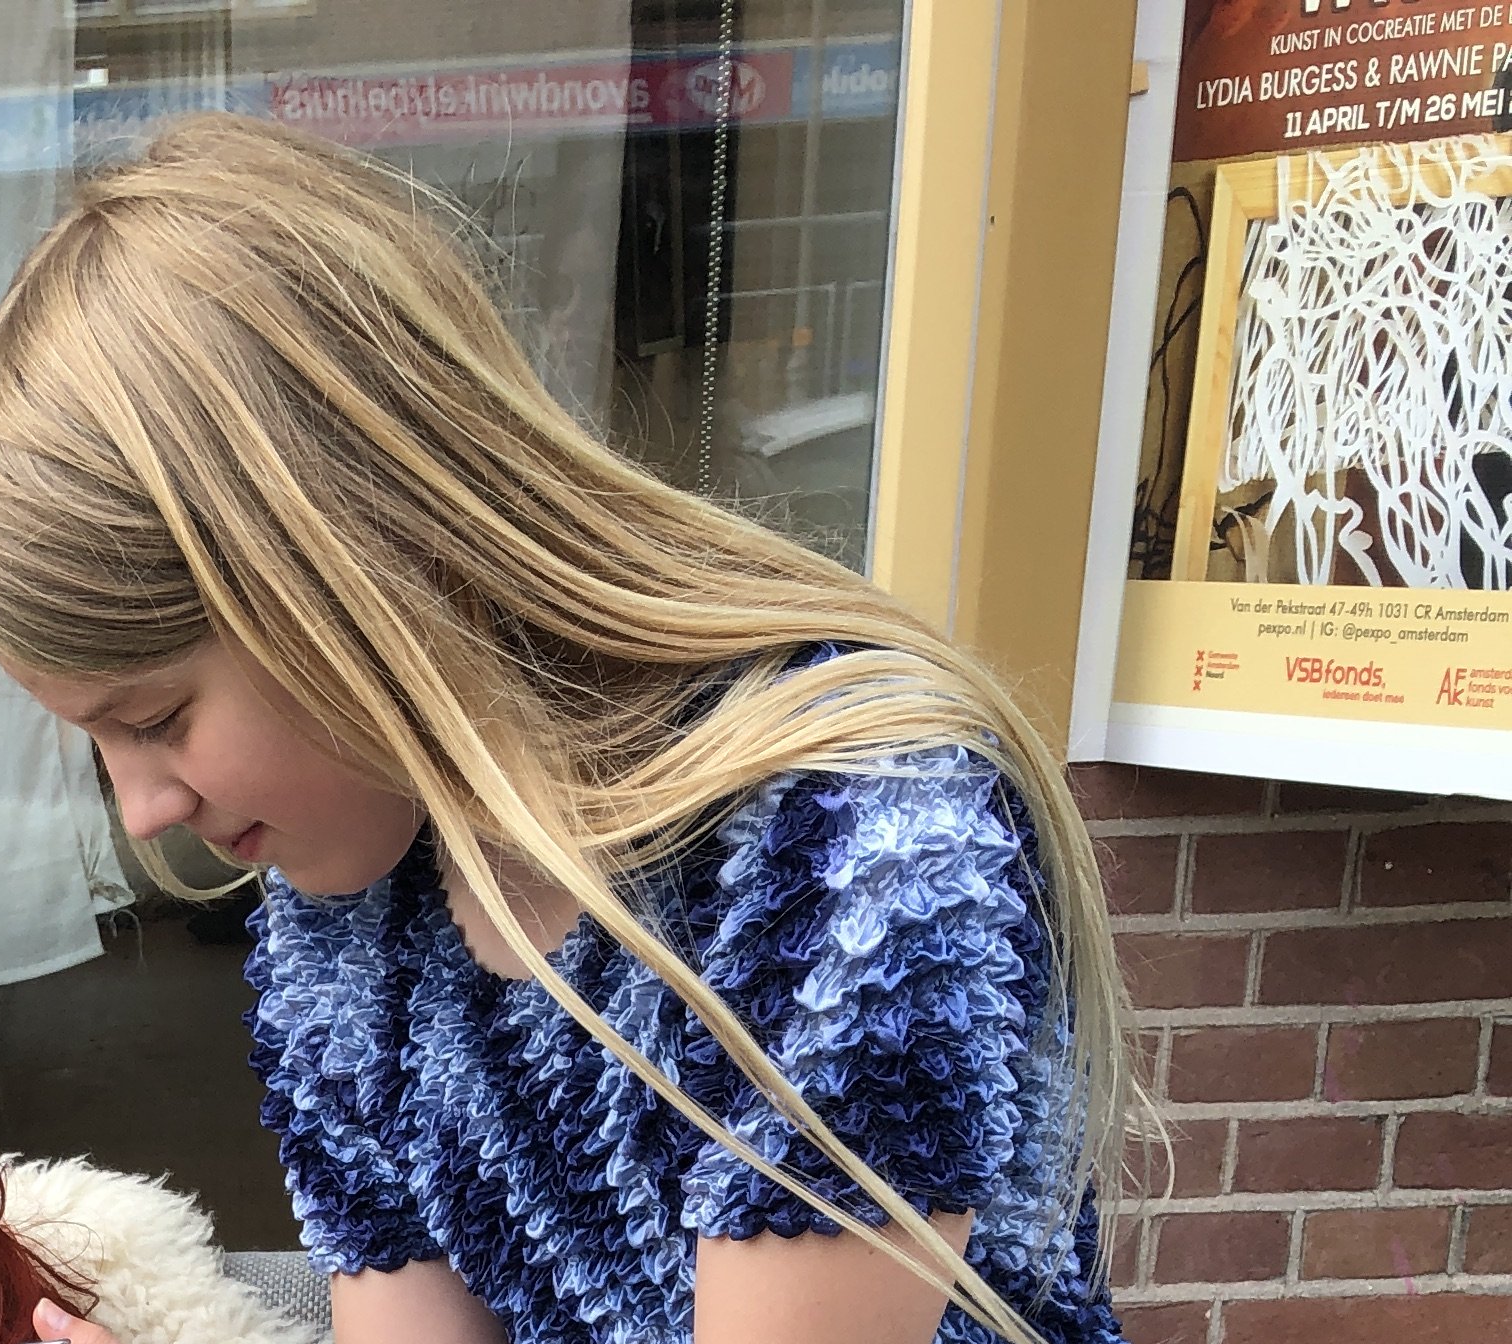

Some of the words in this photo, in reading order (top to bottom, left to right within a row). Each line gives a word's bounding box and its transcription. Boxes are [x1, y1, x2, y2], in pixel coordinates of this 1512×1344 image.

[1270, 29, 1321, 56] KUNST
[1323, 26, 1343, 48] IN
[1346, 13, 1436, 45] COCREATIE
[1439, 8, 1476, 33] MET
[1479, 4, 1504, 28] DE
[1196, 75, 1254, 110] LYDIA
[1259, 59, 1358, 102] BURGESS
[1364, 56, 1382, 88] &
[1388, 44, 1485, 85] RAWNIE
[1283, 111, 1303, 138] 11
[1304, 103, 1371, 136] APRIL
[1375, 97, 1421, 130] T/M
[1423, 93, 1457, 123] 26
[1460, 87, 1506, 119] MEI
[1230, 598, 1251, 613] Van
[1254, 598, 1272, 614] der
[1275, 599, 1327, 616] Pekstraat
[1329, 601, 1373, 618] 47-49h
[1378, 602, 1409, 619] 1031
[1414, 603, 1432, 620] CR
[1434, 605, 1510, 623] Amsterdam
[1257, 620, 1307, 638] pexpo.nl
[1320, 621, 1339, 638] IG:
[1343, 622, 1469, 645] @pexpo_amsterdam
